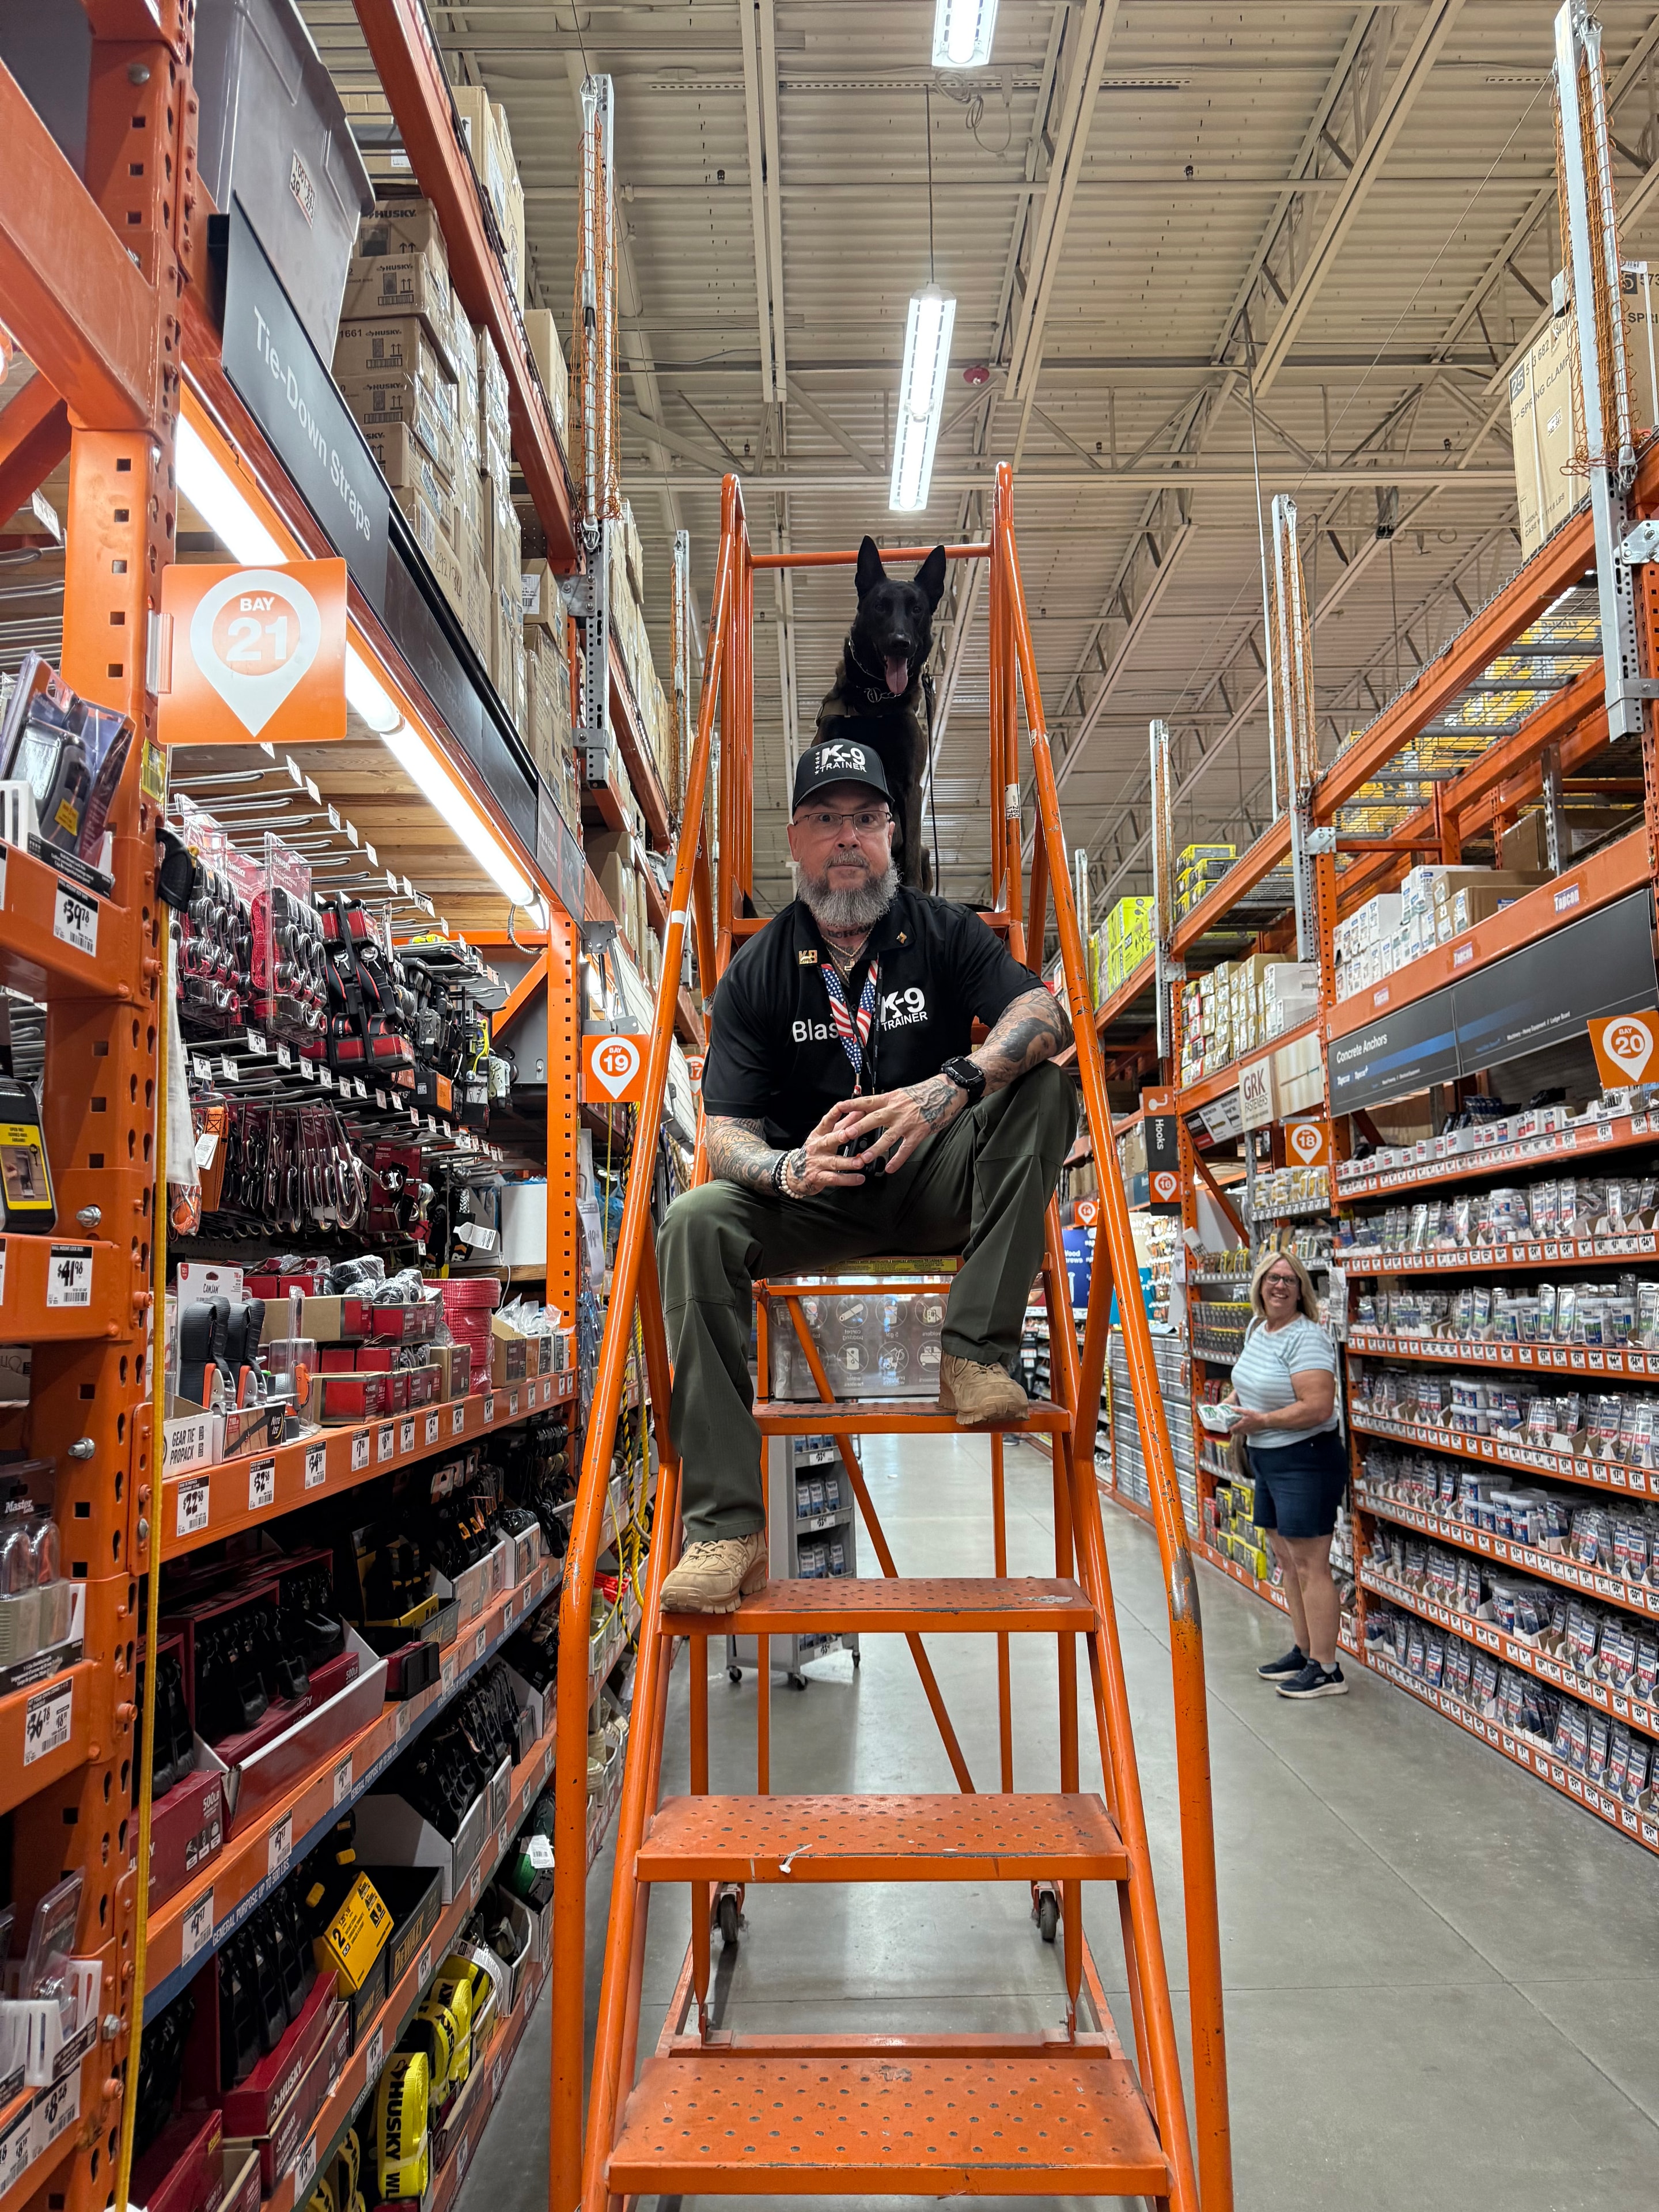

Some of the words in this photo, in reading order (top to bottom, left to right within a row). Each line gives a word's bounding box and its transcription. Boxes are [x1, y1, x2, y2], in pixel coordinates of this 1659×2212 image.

[374, 210, 416, 218] HUSKY
[254, 305, 328, 467] Tie-Down
[330, 448, 371, 541] Straps
[240, 597, 275, 612] BAY
[226, 616, 288, 662] 21
[822, 744, 866, 766] K-9
[819, 760, 867, 773] TRAINER
[1554, 890, 1580, 912] Tapcon
[881, 987, 925, 1023] K-9
[882, 1012, 928, 1031] TRAINER
[1336, 1041, 1362, 1064] Concrete
[1362, 1033, 1388, 1053] Anchors
[1615, 1034, 1645, 1055] 20
[603, 1054, 629, 1073] 19
[1244, 1068, 1266, 1101] GRK
[1155, 1119, 1164, 1150] Hooks
[1298, 1137, 1316, 1147] 18
[172, 1429, 187, 1448] GEAR
[187, 1428, 196, 1443] TIE
[169, 1445, 195, 1466] PROPACK
[4, 1499, 32, 1514] Master
[350, 1783, 366, 1801] GENERAL
[365, 1770, 378, 1787] PURPOSE
[203, 1790, 220, 1811] 500LB
[212, 1915, 236, 1947] GENERAL
[235, 1892, 258, 1925] PURPOSE
[257, 1885, 265, 1900] UP
[264, 1878, 272, 1893] TO
[272, 1869, 281, 1885] 500
[332, 1927, 346, 1950] 2
[280, 2061, 302, 2099] HUSKY
[385, 2083, 402, 2161] HUSKY
